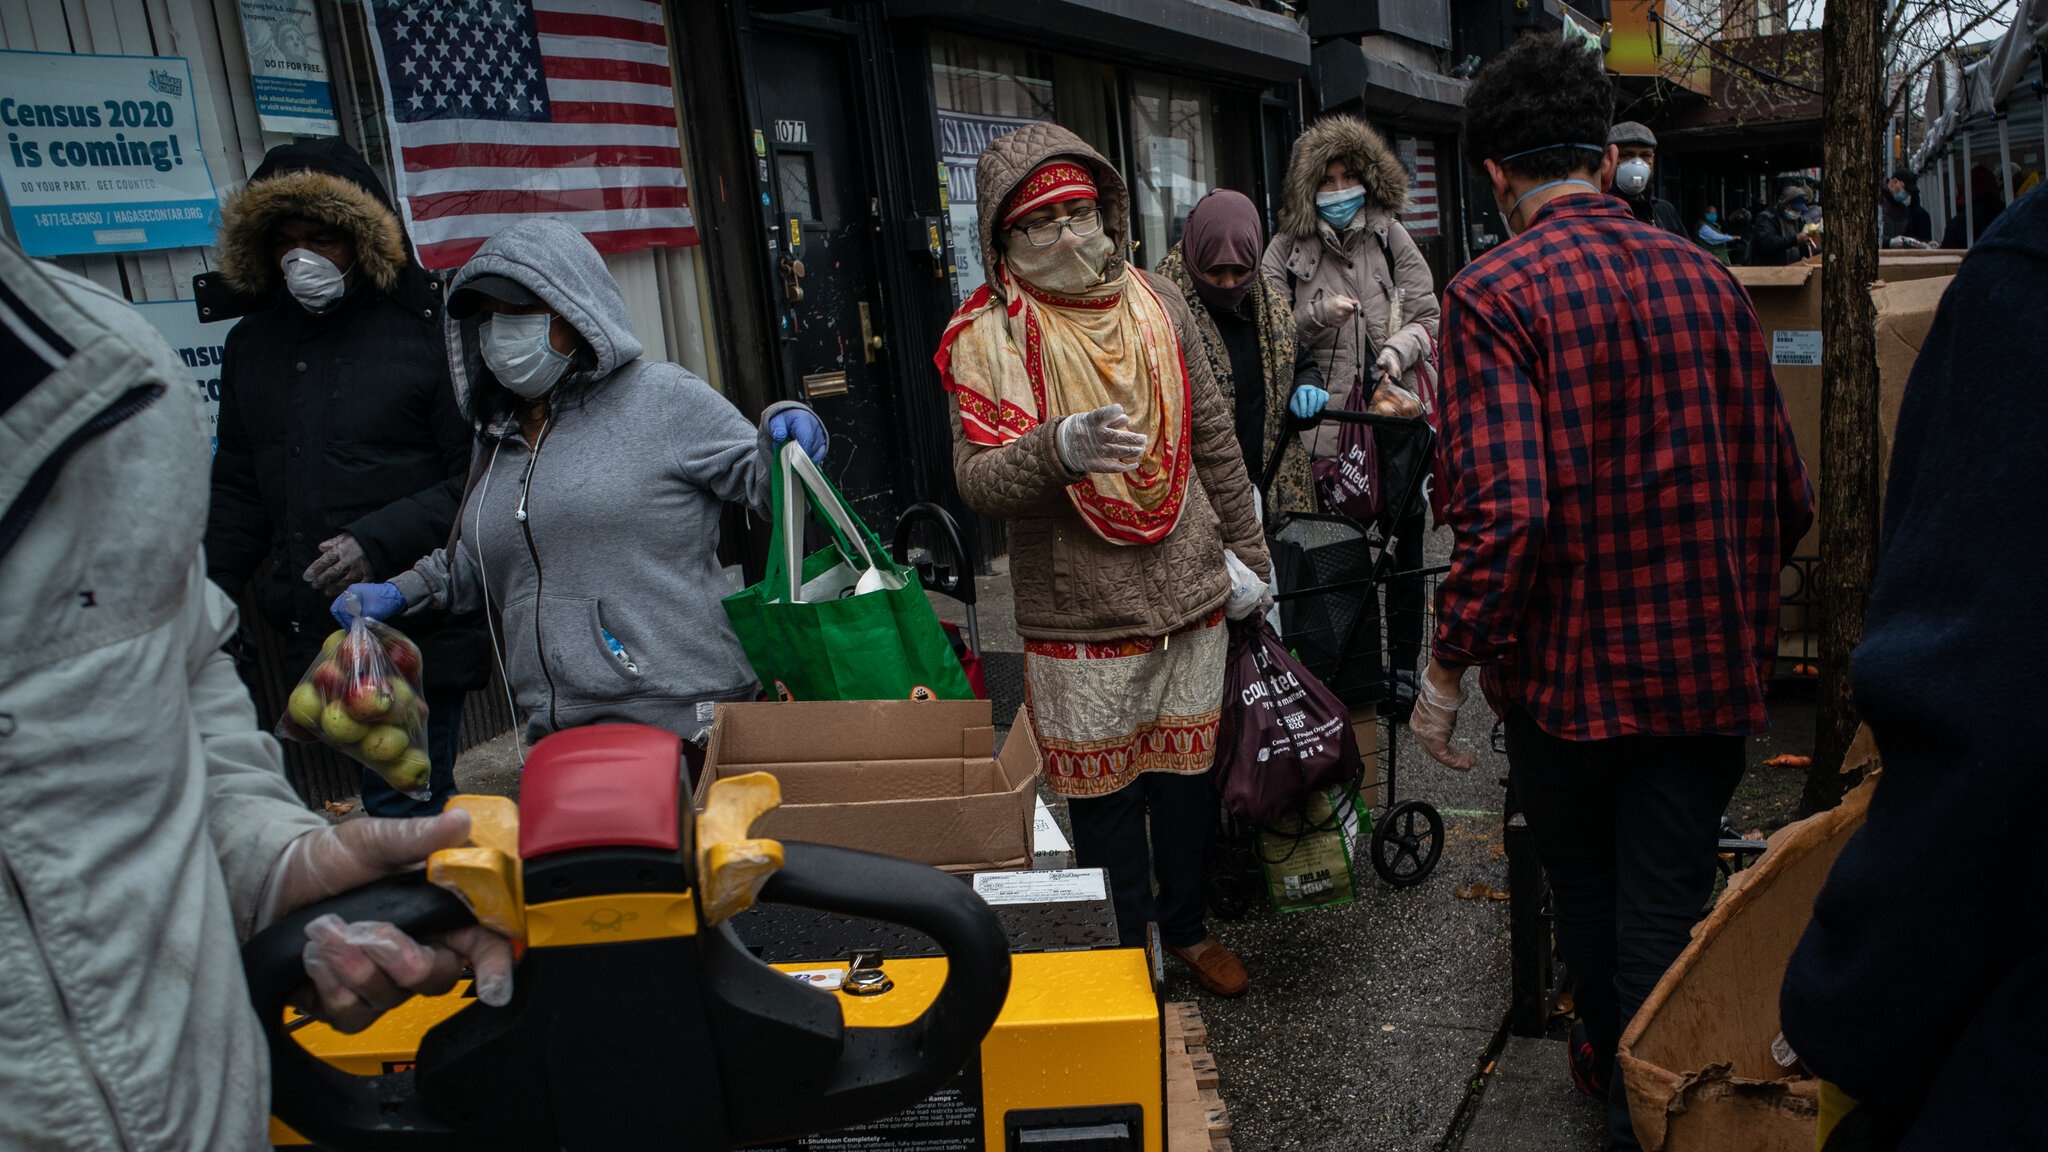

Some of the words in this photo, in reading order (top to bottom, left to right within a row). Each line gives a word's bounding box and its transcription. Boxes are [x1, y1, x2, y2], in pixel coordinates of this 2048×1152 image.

[265, 60, 276, 68] DO
[278, 60, 284, 69] IT
[286, 62, 300, 70] FOR
[304, 64, 323, 72] FREE.
[0, 98, 102, 127] Census
[104, 100, 174, 128] 2020
[776, 120, 804, 141] 1077
[8, 133, 43, 168] is
[49, 133, 184, 172] coming!
[21, 182, 34, 192] DO
[36, 181, 62, 192] YOUR
[64, 180, 90, 192] PART.
[97, 180, 114, 191] GET
[34, 212, 103, 227] 1-877-EL-CENSO
[114, 207, 204, 224] HAGASECONTAR.ORG
[843, 1136, 880, 1144] Completely
